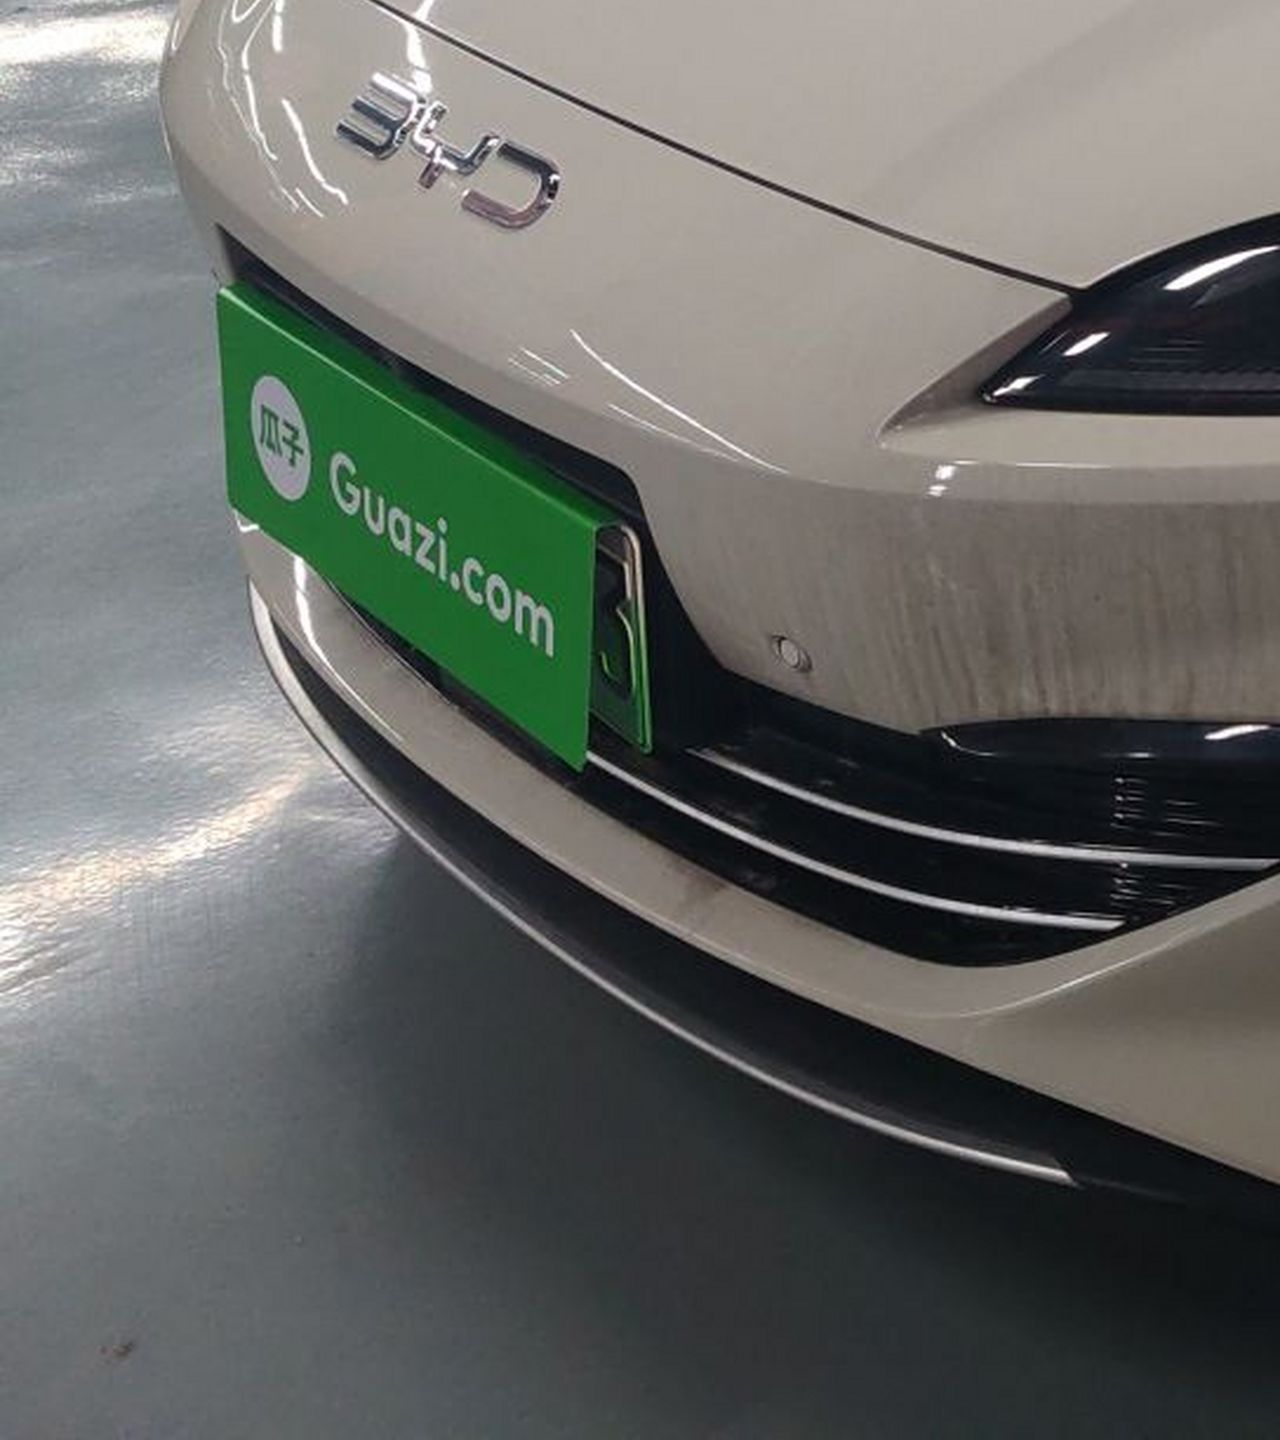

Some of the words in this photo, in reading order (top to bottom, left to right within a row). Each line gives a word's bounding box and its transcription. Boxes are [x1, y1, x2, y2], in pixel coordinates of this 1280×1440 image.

[337, 72, 560, 230] BYD
[259, 403, 304, 467] 瓜子
[329, 452, 554, 658] Guazi.com
